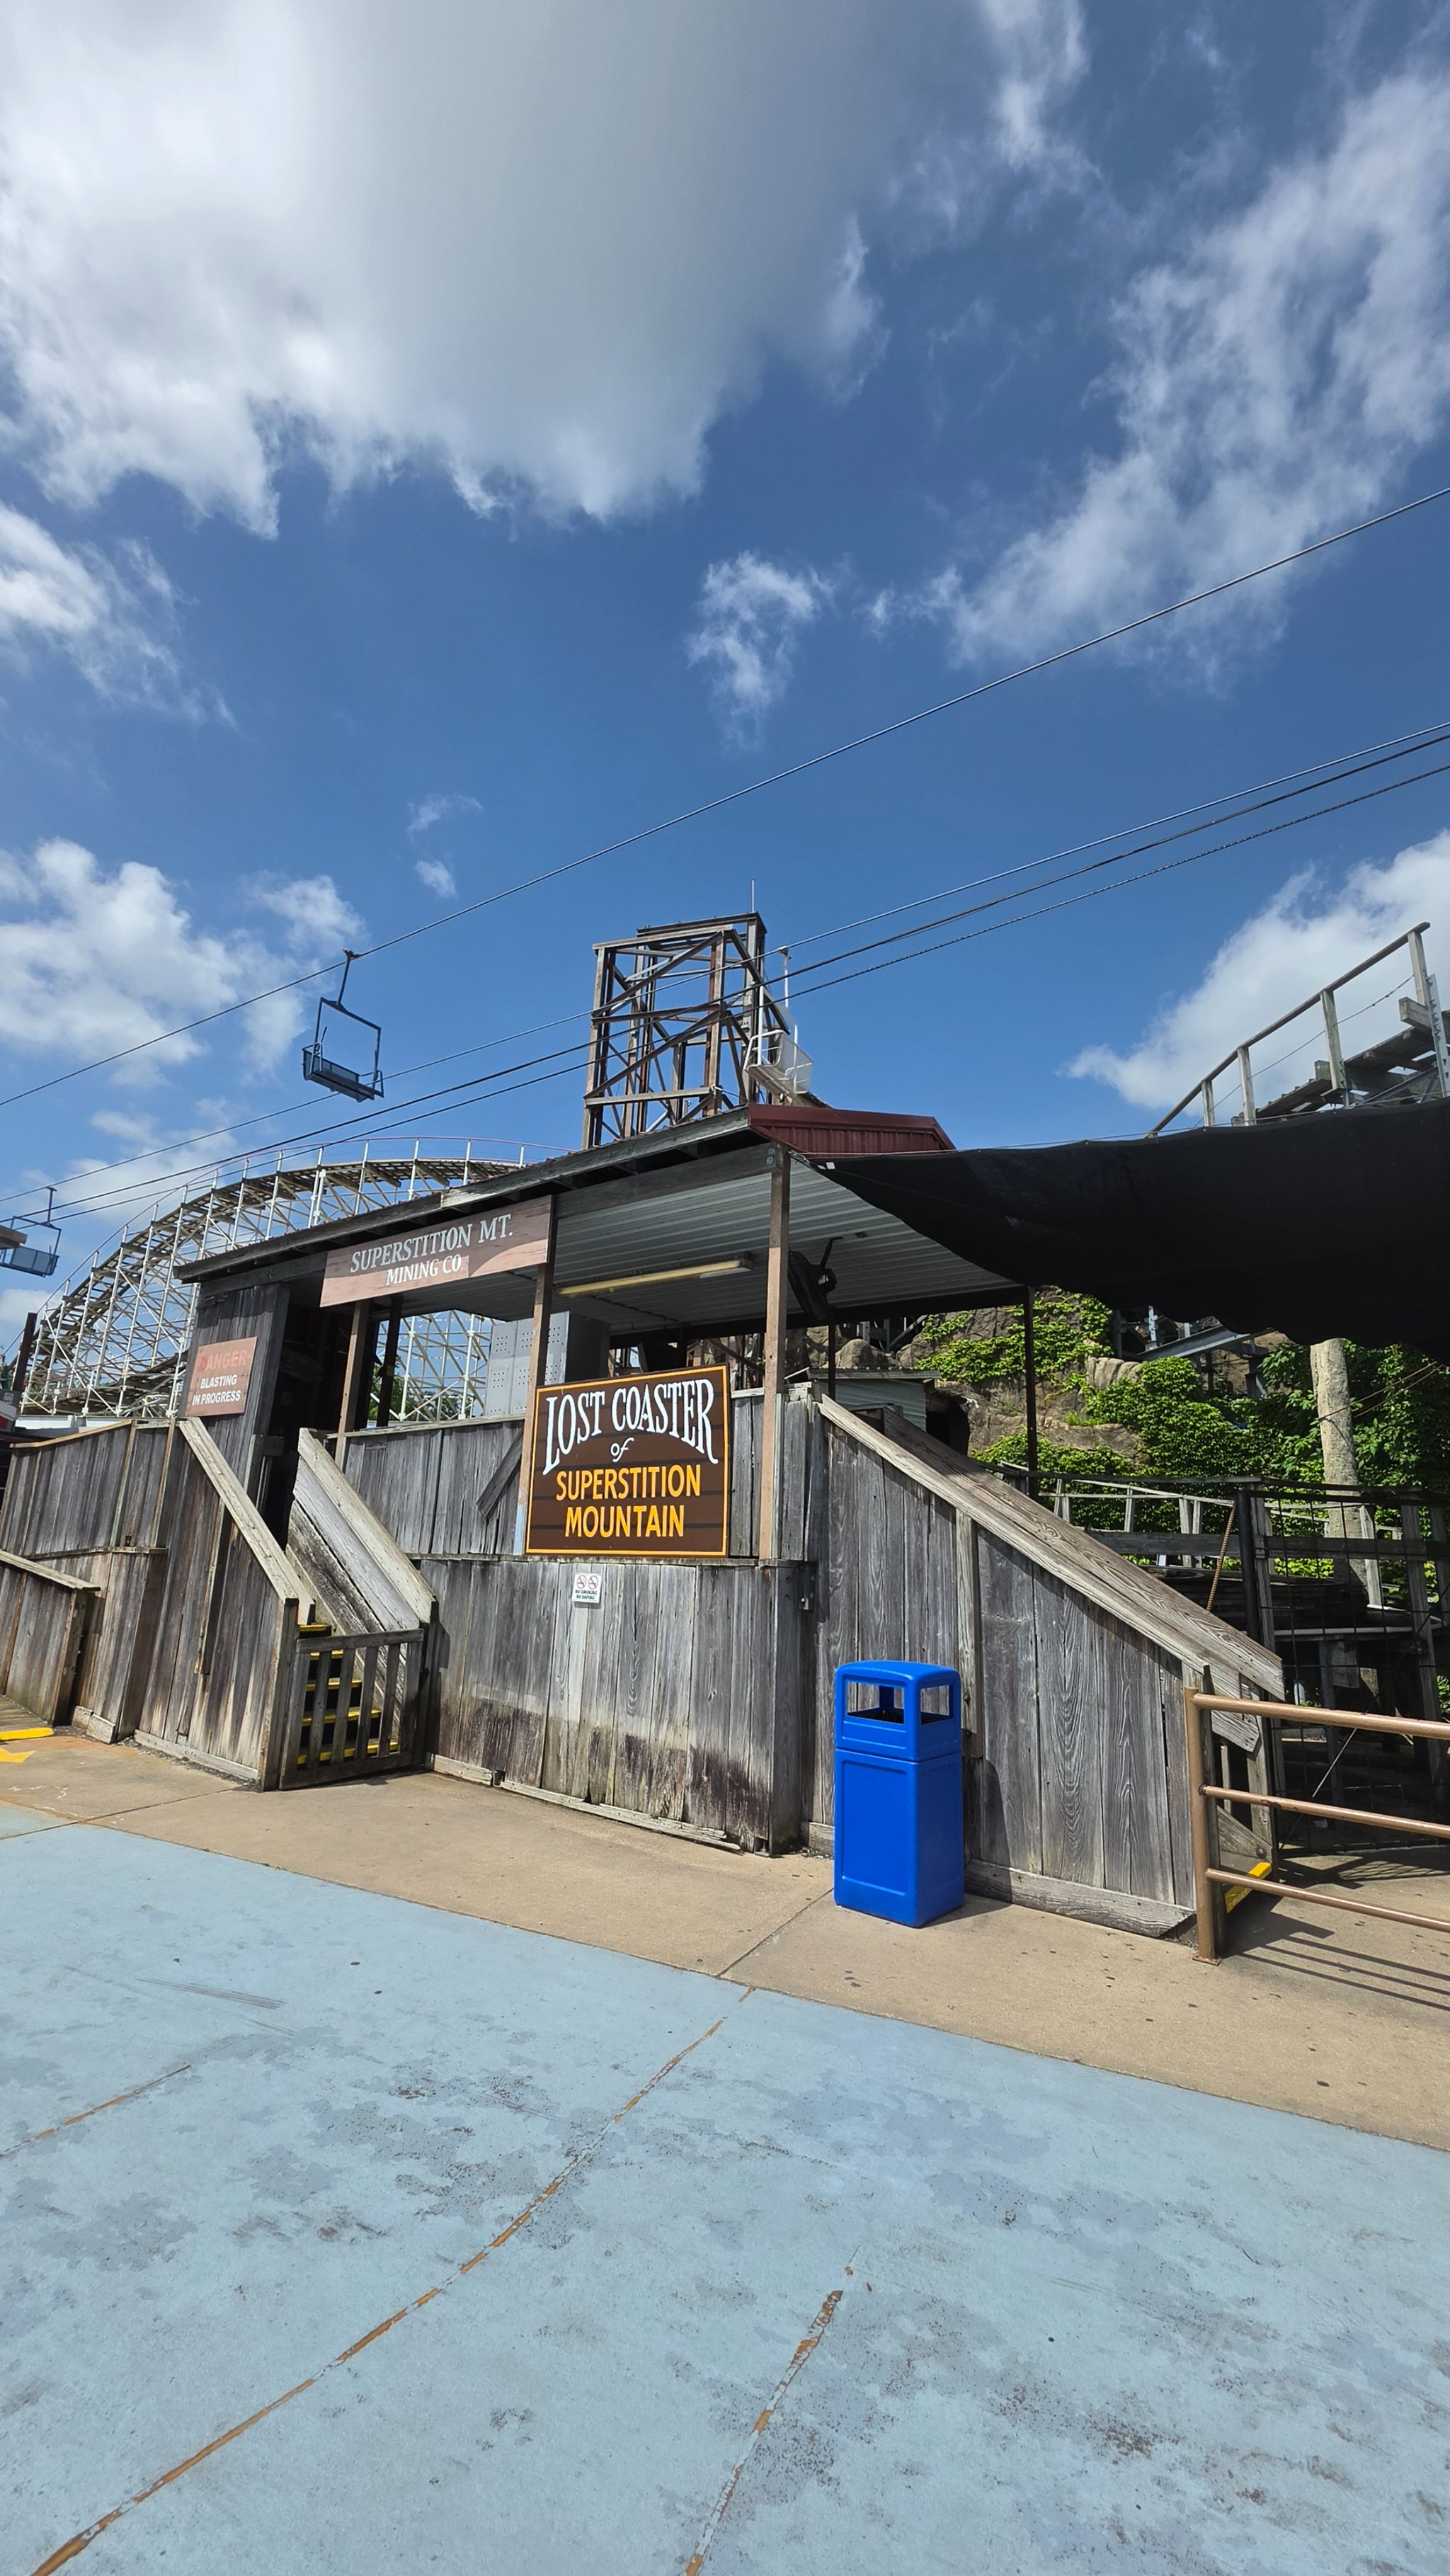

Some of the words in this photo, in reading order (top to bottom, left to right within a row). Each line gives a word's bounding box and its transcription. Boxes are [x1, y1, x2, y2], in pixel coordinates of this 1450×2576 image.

[350, 1224, 472, 1273] SUPERSTITION
[478, 1214, 513, 1244] MT.
[385, 1258, 439, 1286] MINING
[198, 1350, 248, 1372] DANGER
[200, 1374, 238, 1389] BLASTING
[192, 1394, 200, 1406] IN
[201, 1390, 241, 1405] PROGRESS
[542, 1391, 605, 1476] LOST
[612, 1379, 719, 1464] COASTER
[610, 1437, 634, 1463] of
[555, 1464, 701, 1501] SUPERSTITION
[564, 1505, 685, 1537] MOUNTAIN
